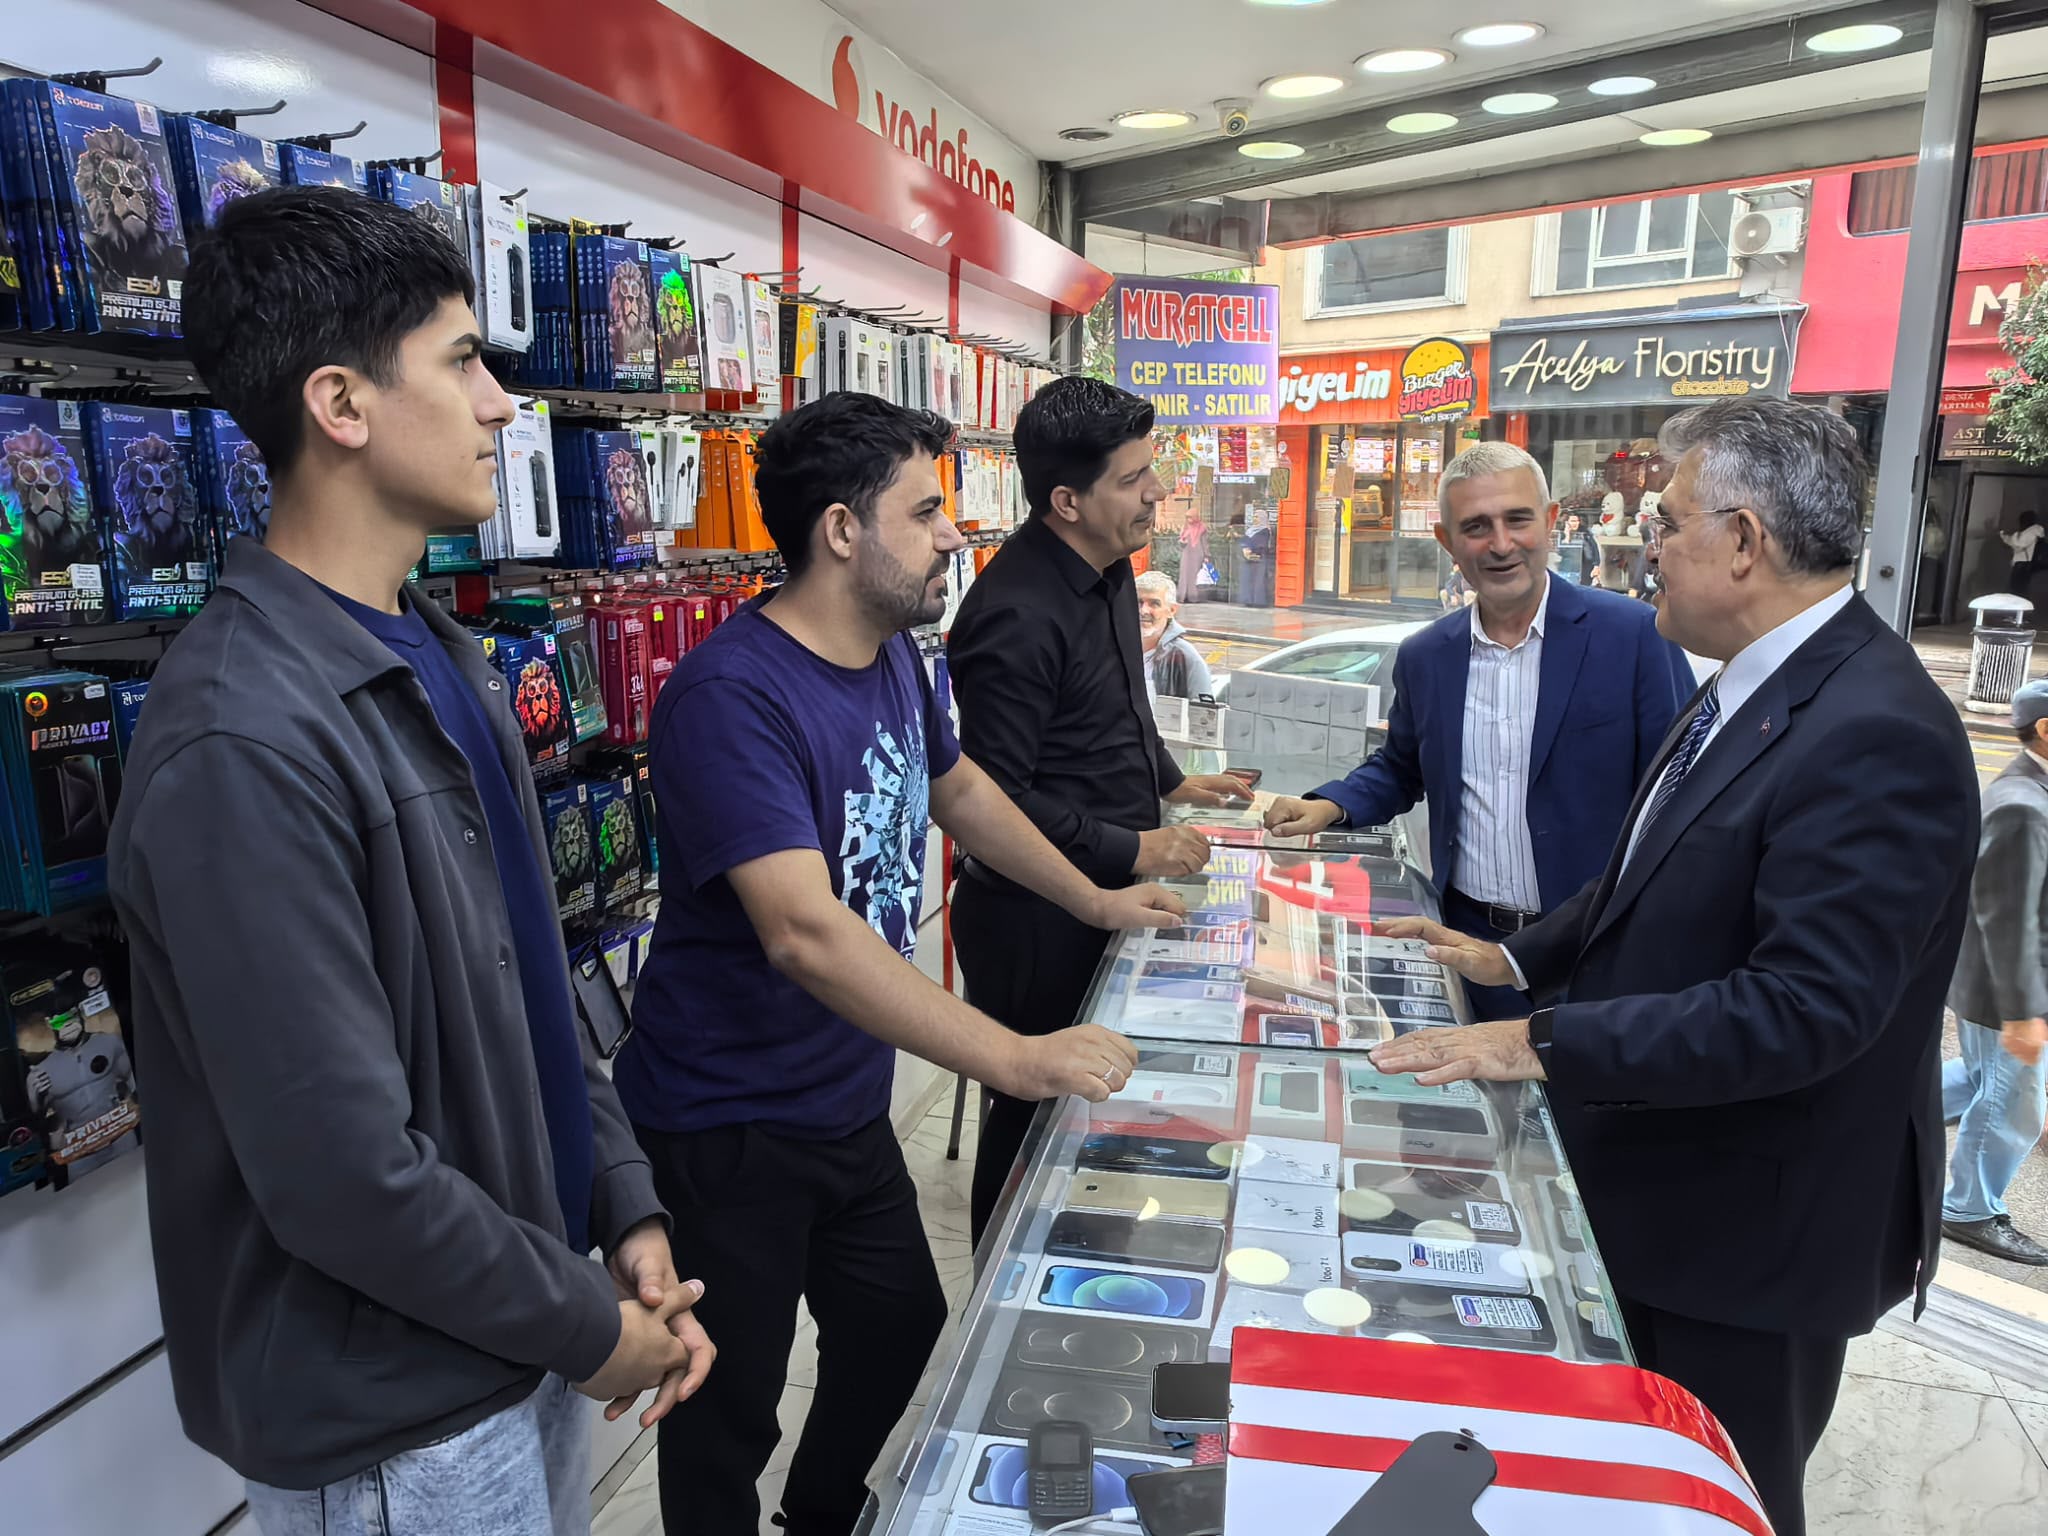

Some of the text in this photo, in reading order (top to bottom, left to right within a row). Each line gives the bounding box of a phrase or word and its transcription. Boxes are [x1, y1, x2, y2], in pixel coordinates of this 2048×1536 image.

[875, 89, 1015, 216] vodafone
[1120, 287, 1273, 349] MURATCELL
[1130, 360, 1267, 387] CEP TELEFONU
[1634, 335, 1776, 390] Floristry
[1205, 394, 1272, 417] SATILIR
[14, 590, 66, 602] PREMIUM
[128, 585, 174, 596] PREMIUM
[128, 593, 205, 608] ANTI-STATIC
[15, 599, 104, 615] ANTI-STATIC
[32, 720, 110, 751] PRIVACY
